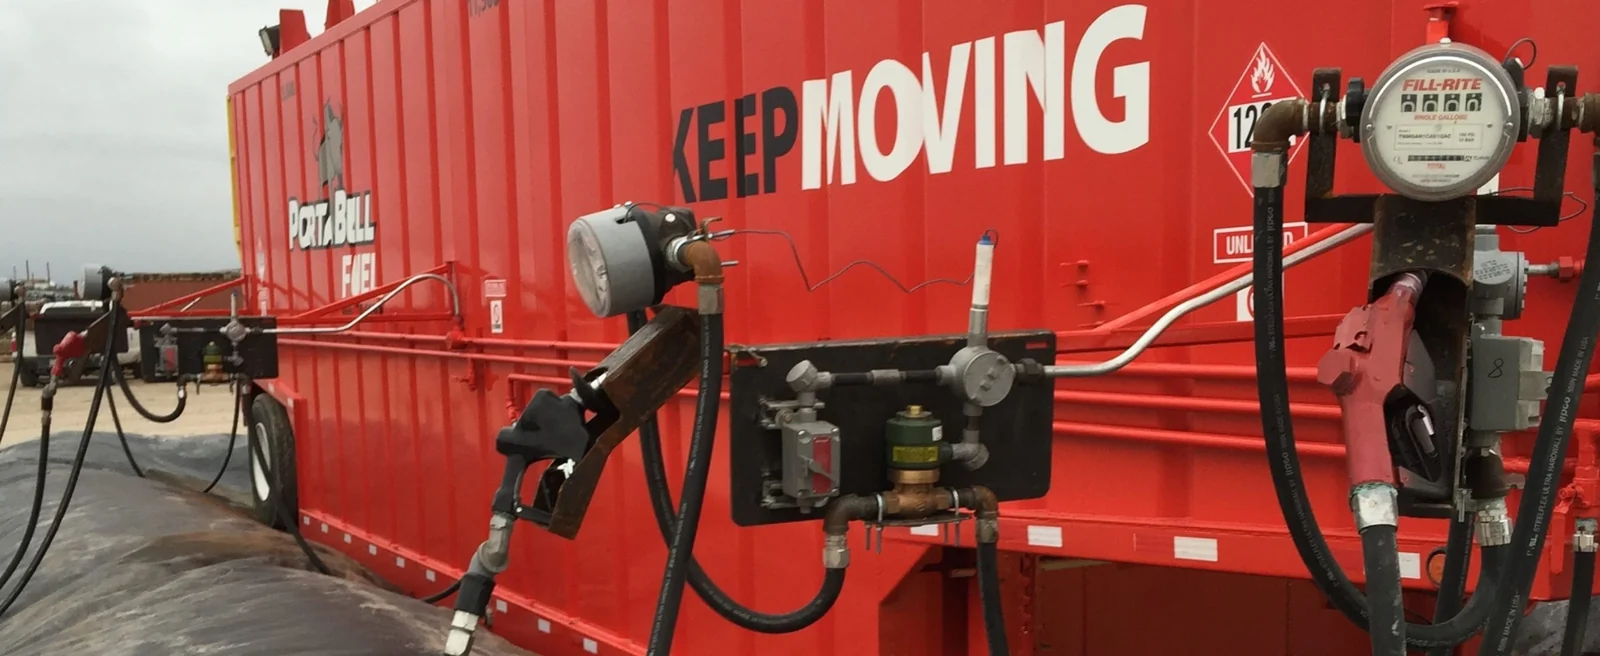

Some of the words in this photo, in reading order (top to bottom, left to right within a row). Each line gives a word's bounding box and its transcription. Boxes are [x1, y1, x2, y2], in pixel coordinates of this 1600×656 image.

[1402, 78, 1482, 91] FILL-RITE
[341, 252, 377, 299] FUEL
[1487, 357, 1504, 378] 8
